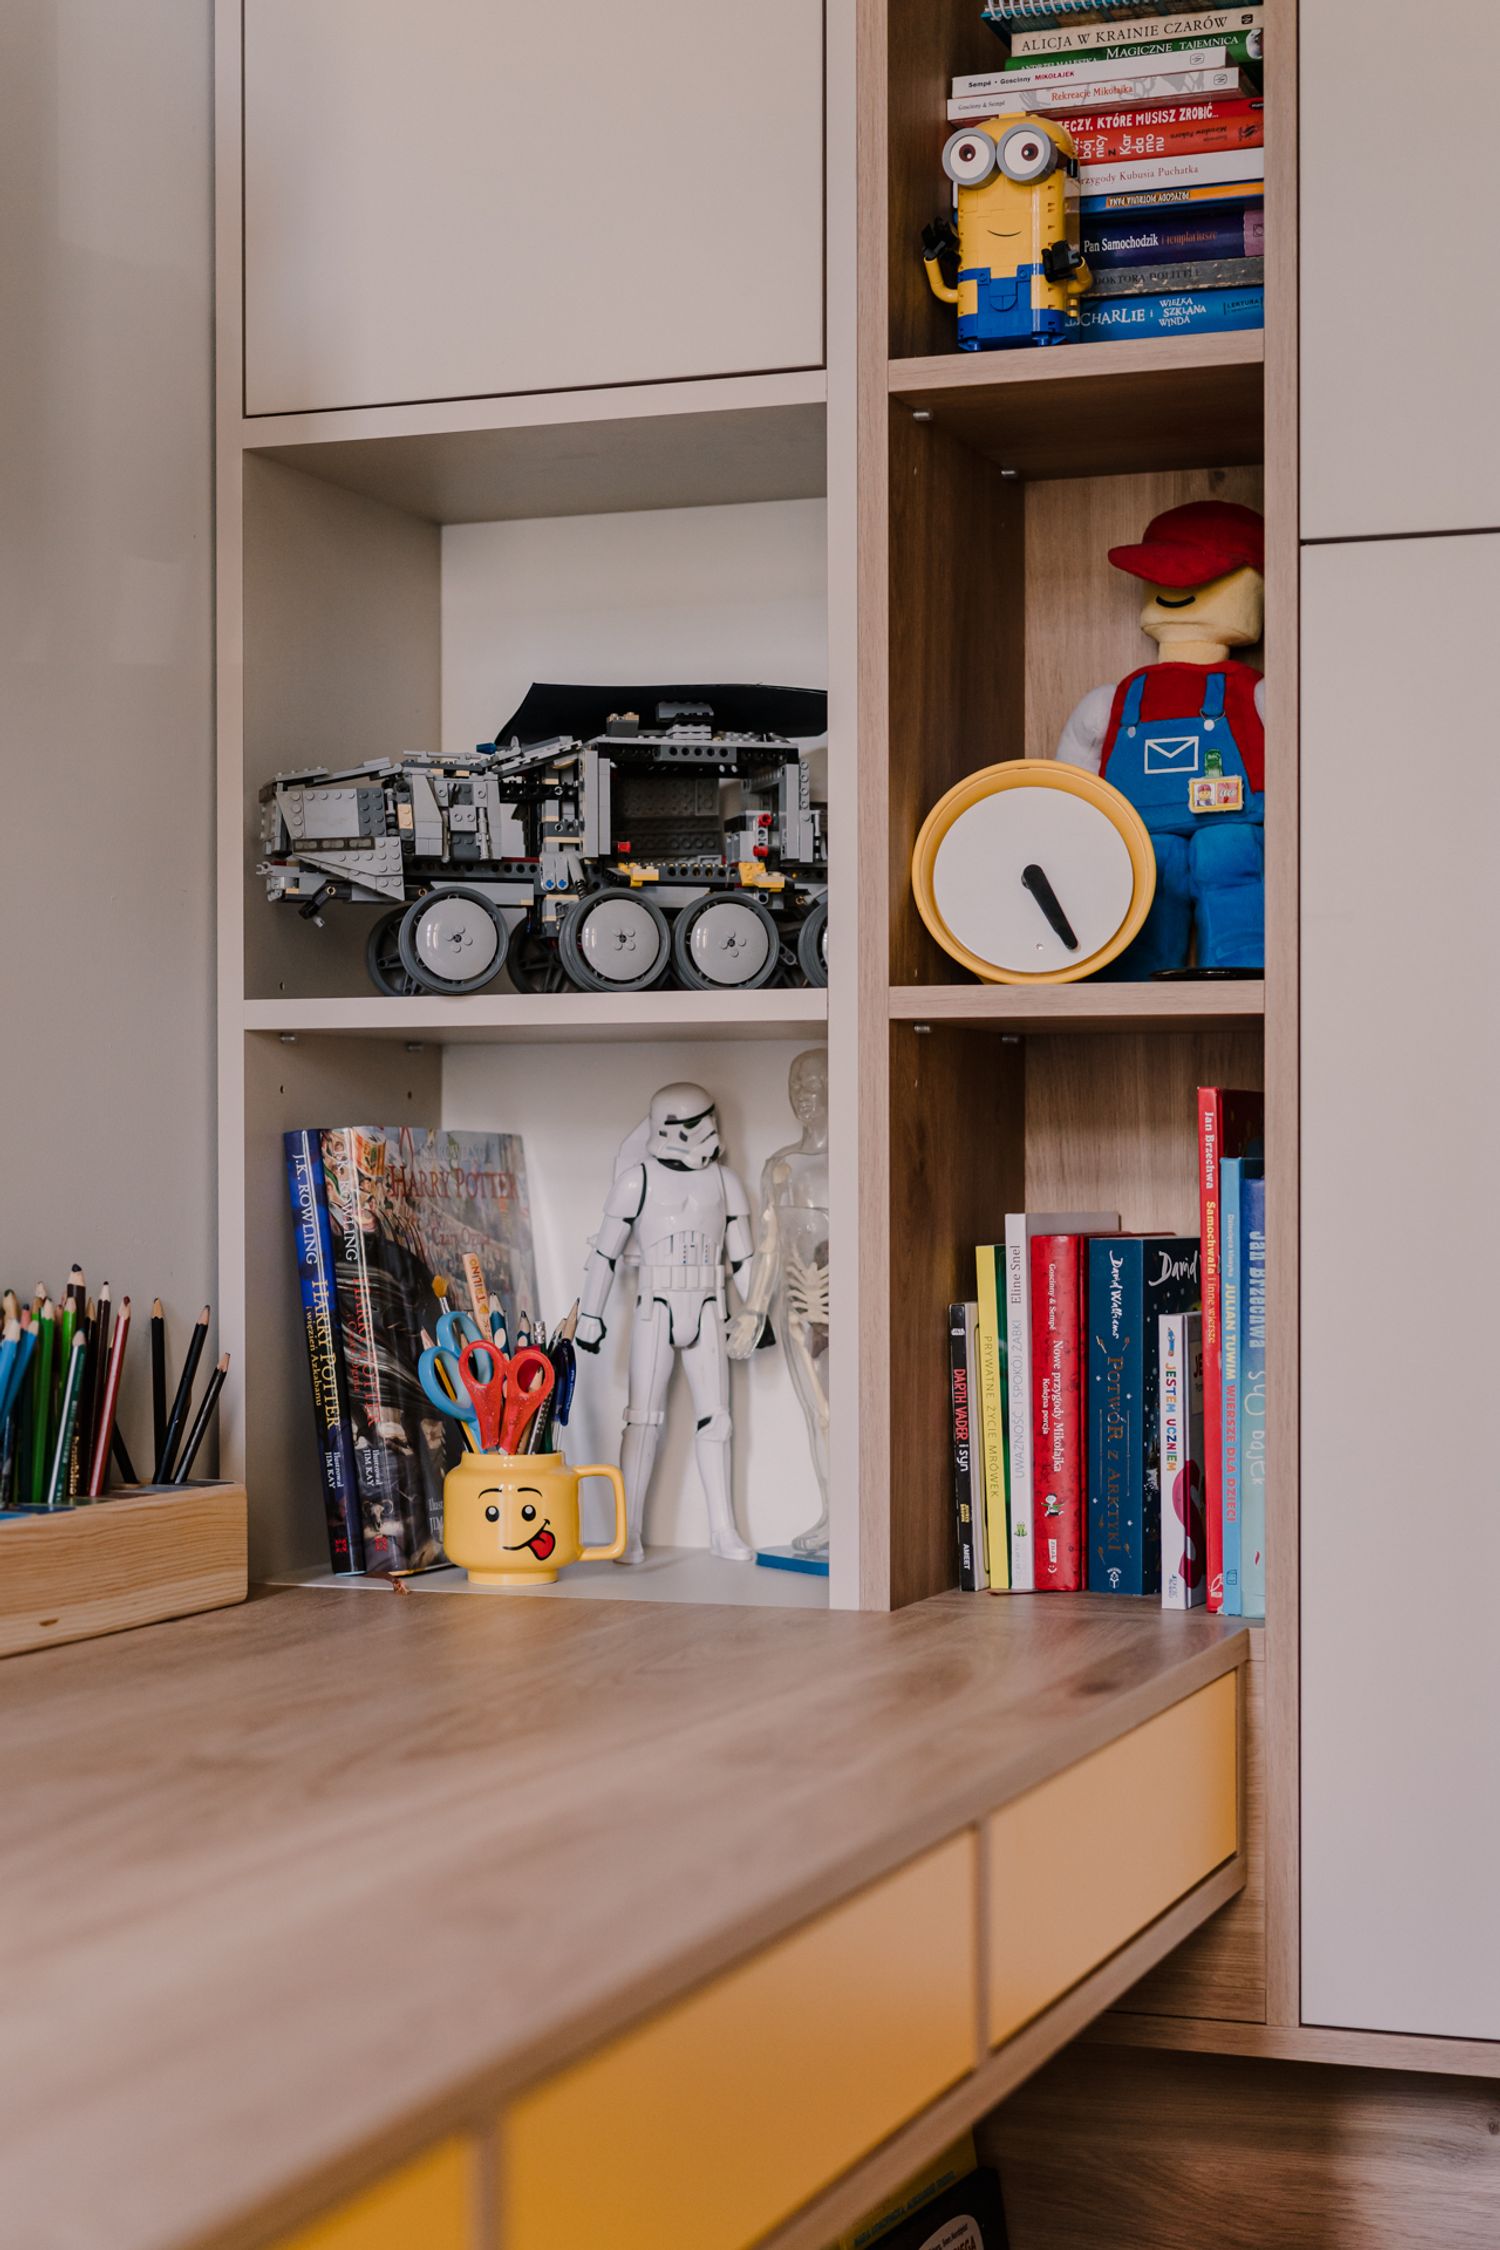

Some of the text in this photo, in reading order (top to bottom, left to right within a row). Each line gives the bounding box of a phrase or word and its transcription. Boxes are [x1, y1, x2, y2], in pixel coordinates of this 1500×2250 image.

[1022, 15, 1228, 52] ALICJA W KRAINIE CZARÓW
[1179, 36, 1239, 50] TAJEMNICA
[968, 71, 1075, 88] Sempé Goscinny MIKOŁAJEK
[1051, 84, 1133, 101] Rekreacje Mikołajka
[1096, 113, 1133, 129] KTÓRE
[1135, 108, 1176, 126] MUSISZ
[1093, 134, 1108, 158] nicy
[1119, 133, 1131, 155] Kar
[1131, 137, 1144, 153] da
[1146, 133, 1154, 153] mo
[1156, 137, 1164, 152] nu
[1077, 165, 1199, 186] rzygody Kubusia Puchatka
[1084, 240, 1100, 252] Pan
[1101, 233, 1159, 251] Samochodzik
[1079, 308, 1145, 326] CHARLIE
[1159, 297, 1194, 308] WIELKA
[1163, 304, 1207, 318] SZKLANA
[1158, 316, 1191, 327] WINDA
[1204, 1112, 1214, 1132] Jan
[1205, 1135, 1215, 1189] Brzechwa
[388, 1165, 519, 1200] HARRY POTTER
[292, 1154, 319, 1265] J.K. ROWLING
[339, 1180, 358, 1262] ROWLING
[1206, 1202, 1216, 1274] Samochwała
[1010, 1245, 1021, 1304] Eline Snel
[1048, 1263, 1057, 1297] Goscinny
[1109, 1250, 1124, 1289] David
[1149, 1250, 1198, 1287] David
[353, 1278, 371, 1344] HARRY
[1207, 1282, 1216, 1306] inne
[306, 1314, 318, 1352] więzień
[1010, 1320, 1023, 1351] ŻABKI
[1207, 1307, 1216, 1345] wiersze
[311, 1279, 341, 1430] HARRY POTTER
[311, 1354, 323, 1407] Azkabanu
[954, 1368, 968, 1403] DARTH
[1011, 1355, 1024, 1400] SPOKÓJ
[984, 1336, 1000, 1497] PRYWATNE ŻYCIE MRÓWEK
[1041, 1378, 1050, 1435] Kolejna porcja
[1051, 1340, 1065, 1472] Nowe przygody Mikołajka
[1107, 1356, 1127, 1443] POTWÓR
[1165, 1362, 1178, 1472] JESTEM UCZNIEM
[1225, 1284, 1237, 1522] JULIAN TUWIM WIERSZE DLA DZIECI
[955, 1406, 969, 1440] VADER
[956, 1450, 969, 1472] syn
[1013, 1410, 1025, 1479] UWAŻNOŚĆ
[324, 1451, 336, 1489] JIM KAY
[363, 1449, 375, 1487] JIM KAY
[1107, 1468, 1122, 1551] ARKTYKI
[963, 1544, 971, 1570] AMEET
